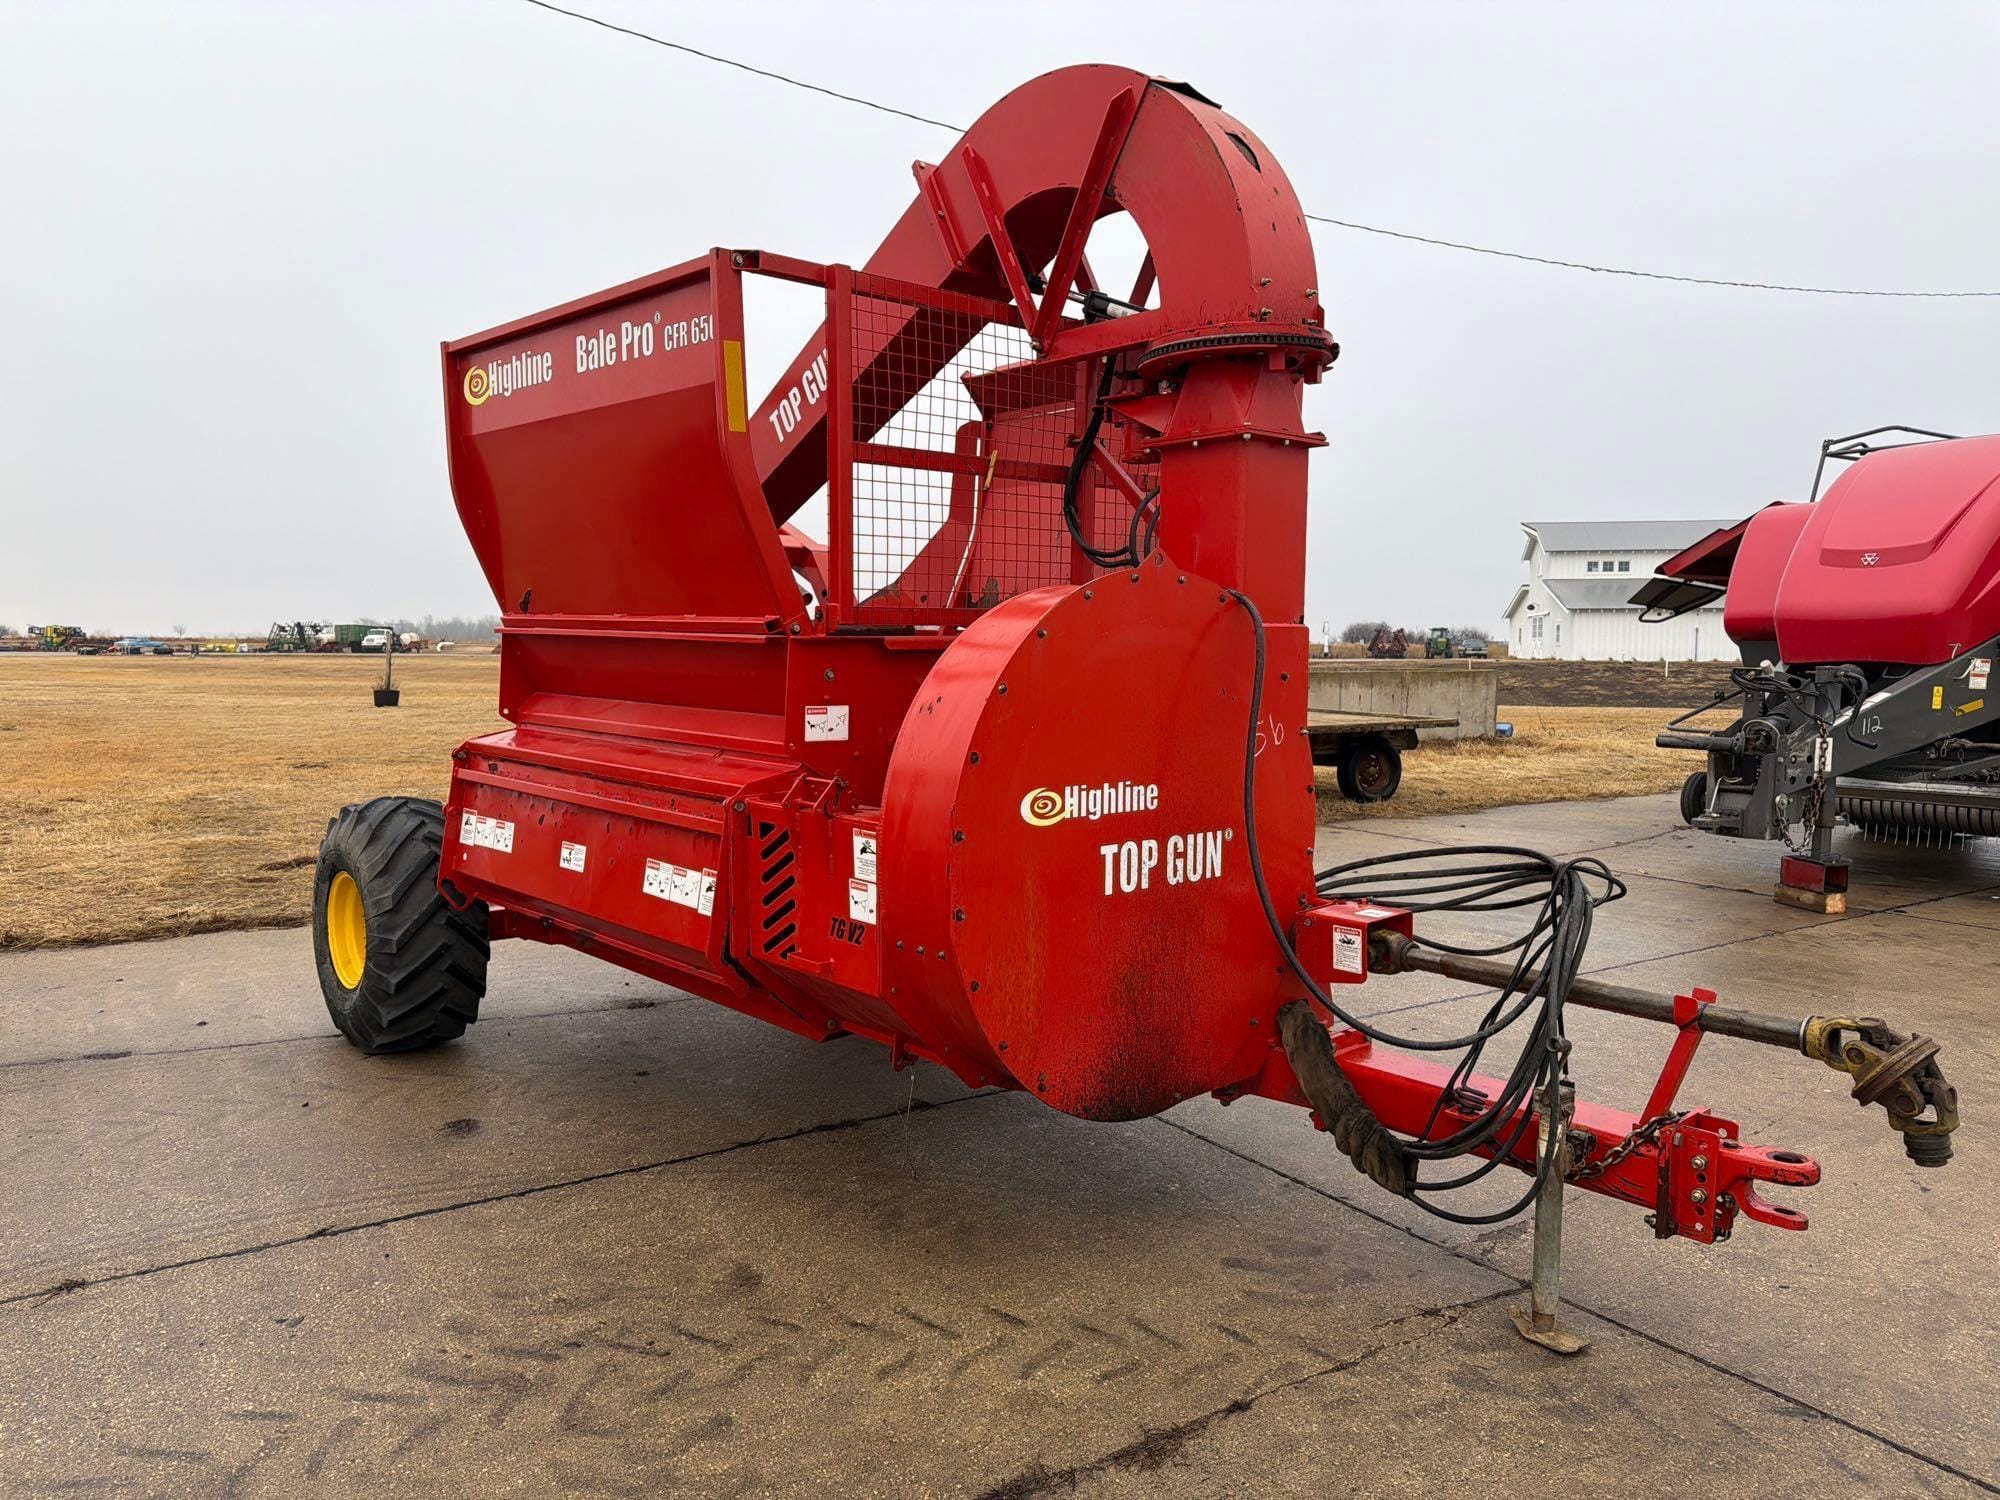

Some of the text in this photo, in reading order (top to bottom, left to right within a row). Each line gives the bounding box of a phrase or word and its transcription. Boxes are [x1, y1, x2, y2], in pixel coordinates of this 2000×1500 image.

[576, 328, 617, 374] Bale
[621, 321, 654, 362] Pro
[664, 321, 688, 351] CFR
[488, 350, 553, 397] Highline
[769, 348, 829, 443] TOP GU
[1862, 715, 1884, 736] 112
[1064, 781, 1159, 820] Highline
[1100, 830, 1223, 896] TOP GUN
[829, 916, 865, 945] TG V2
